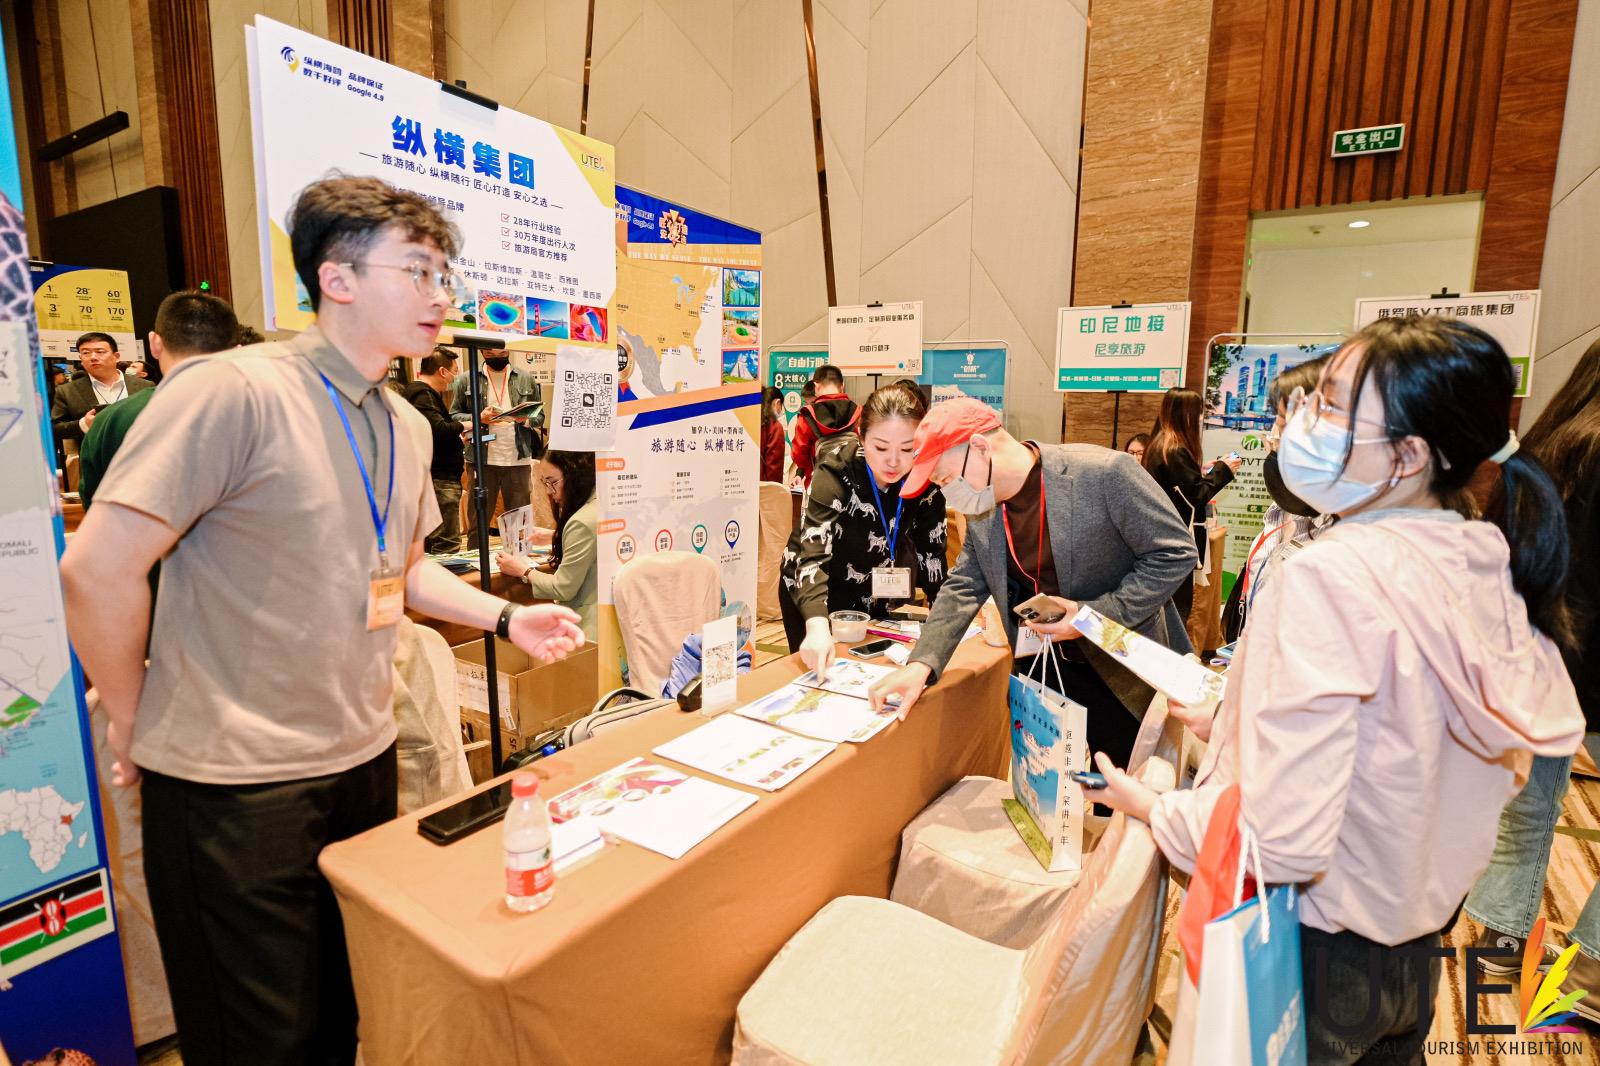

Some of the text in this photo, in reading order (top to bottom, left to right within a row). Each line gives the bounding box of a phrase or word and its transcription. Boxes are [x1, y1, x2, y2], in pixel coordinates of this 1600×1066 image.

[303, 67, 342, 87] 数千好评
[347, 84, 385, 102] Google 4.9
[1342, 129, 1396, 146] 安全出口
[1349, 141, 1384, 151] EXIT
[391, 114, 535, 190] 纵横集团
[381, 153, 548, 208] 旅游随心 纵横随行 匠心打造 安心之选
[513, 216, 562, 236] 28年行业经验
[513, 230, 576, 251] 30万年度出行人次
[514, 243, 568, 262] 旅游局官方推荐
[76, 287, 89, 296] 28
[107, 290, 120, 299] 60
[50, 303, 57, 313] 3
[107, 307, 126, 317] 170
[1079, 315, 1165, 334] 印尼地接
[1094, 343, 1146, 356] 尼享旅游
[774, 373, 784, 389] 8
[650, 437, 745, 453] 旅游随心 纵横随行
